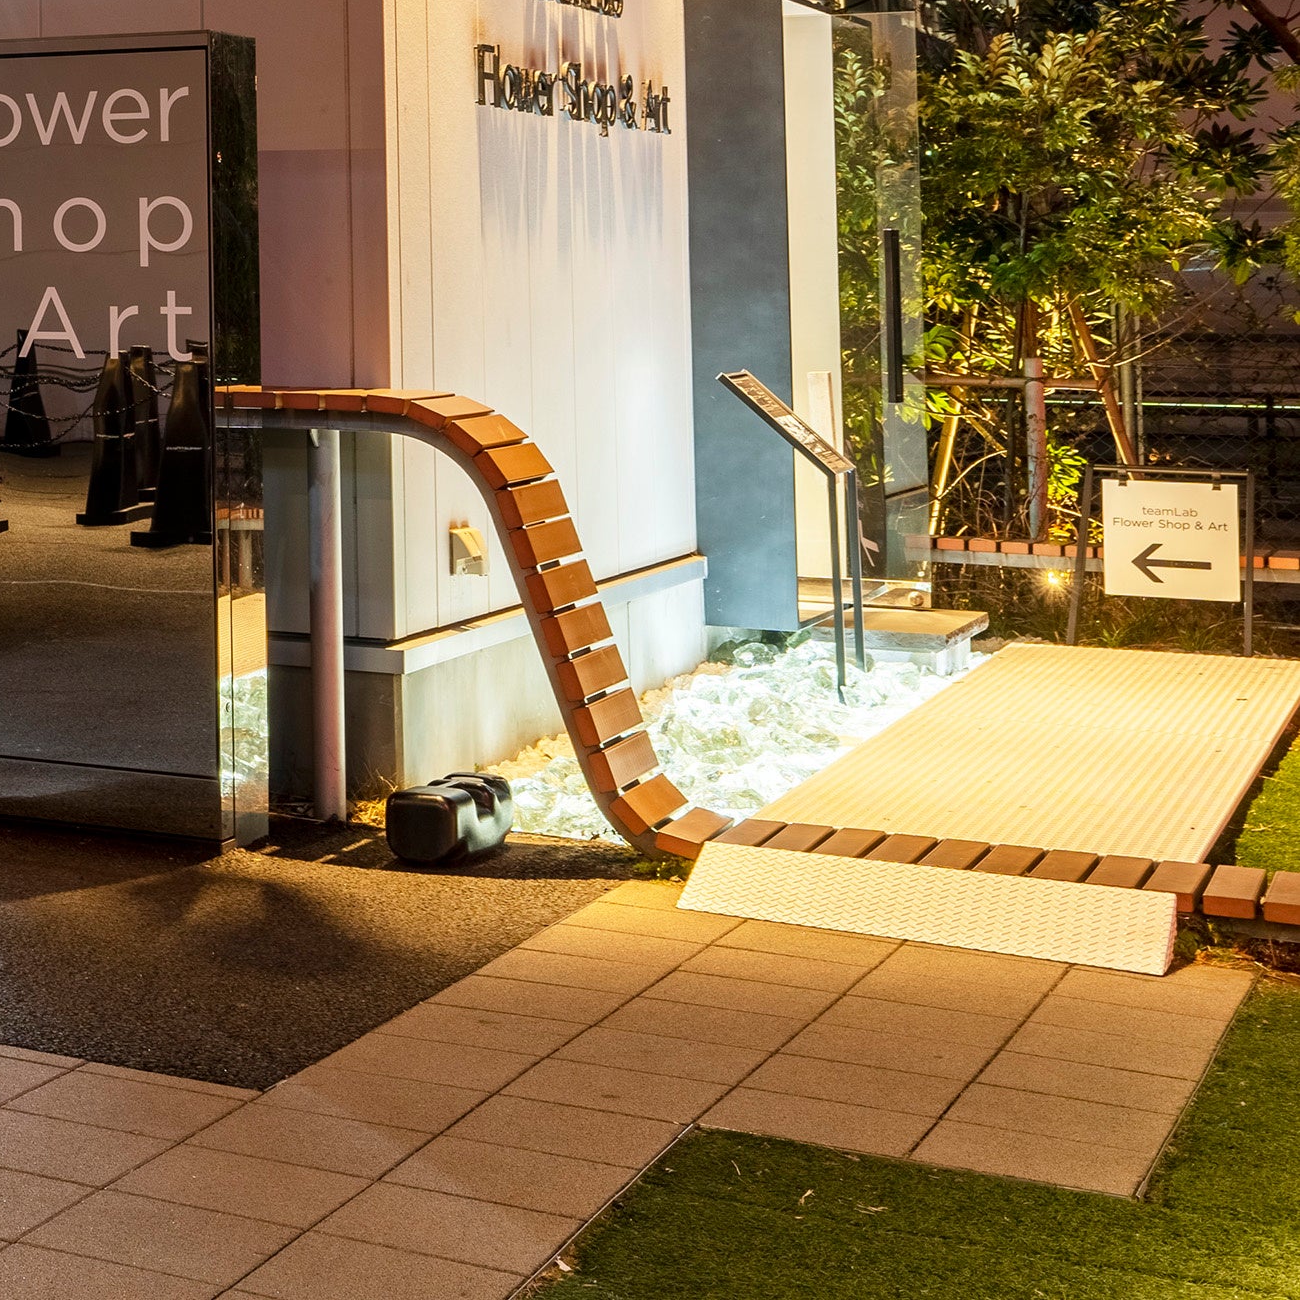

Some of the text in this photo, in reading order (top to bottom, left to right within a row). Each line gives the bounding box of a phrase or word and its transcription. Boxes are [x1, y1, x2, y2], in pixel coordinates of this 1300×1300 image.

[473, 43, 672, 137] Flower Shop & Art
[19, 286, 193, 362] Art
[1112, 517, 1228, 532] Flower Shop & Art
[1142, 506, 1198, 518] teamLab
